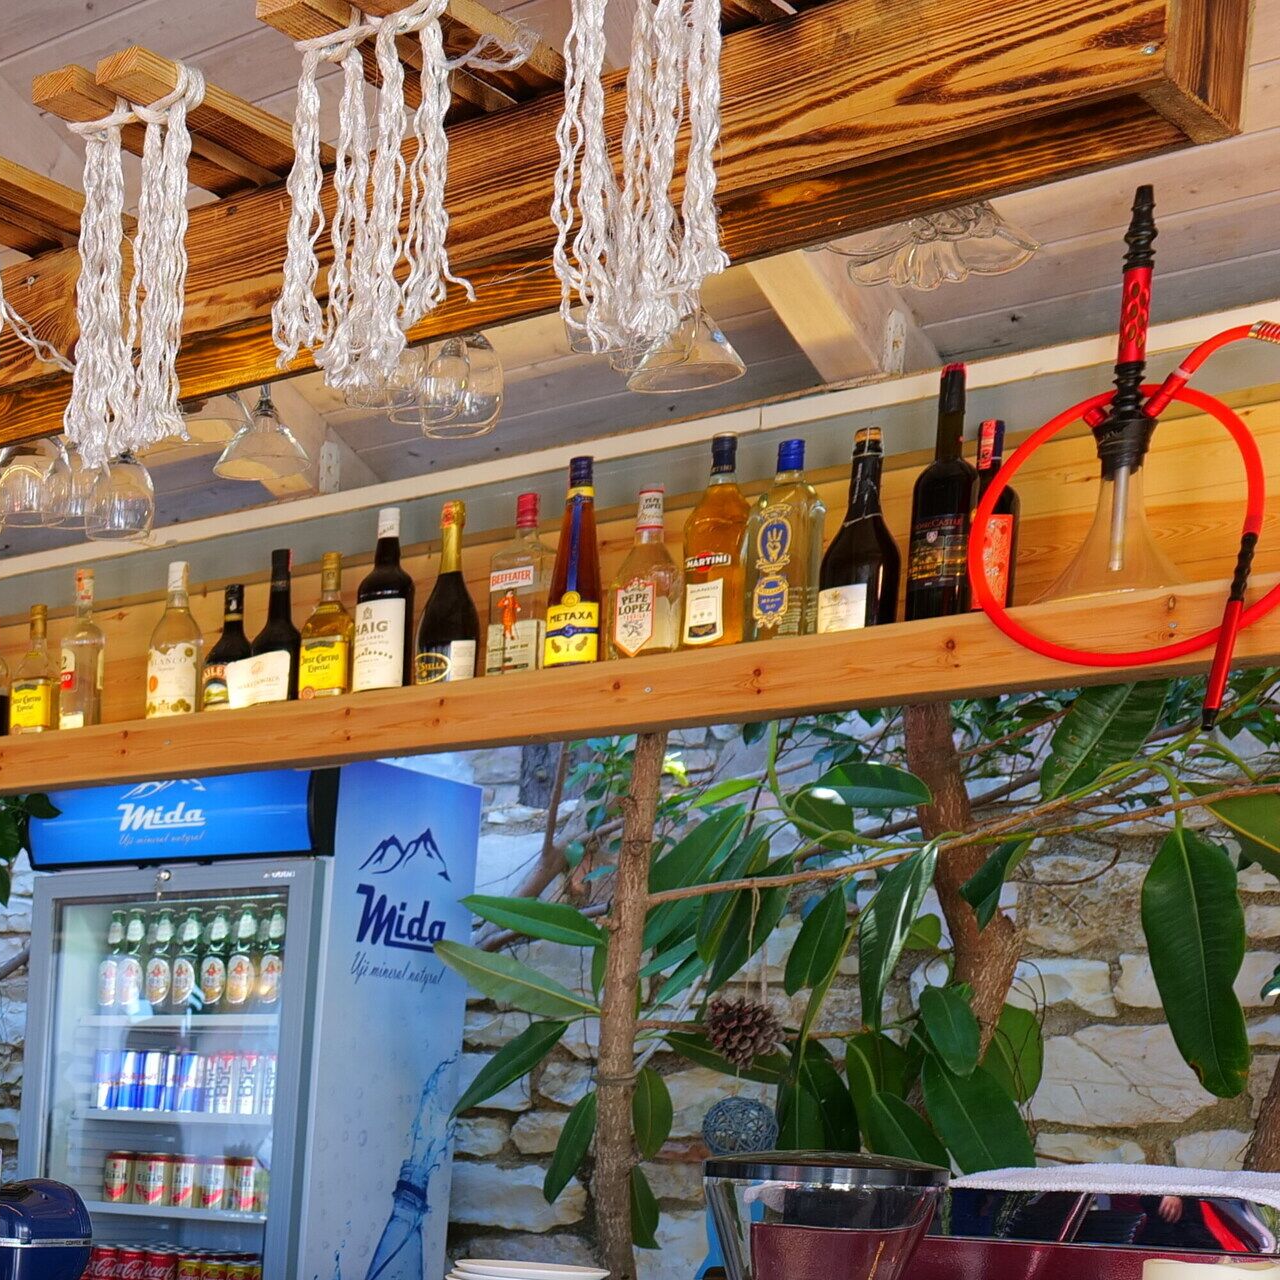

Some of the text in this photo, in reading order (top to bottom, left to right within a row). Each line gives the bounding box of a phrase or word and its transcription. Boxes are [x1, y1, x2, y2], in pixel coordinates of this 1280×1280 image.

[686, 554, 728, 569] MARTINI
[491, 569, 531, 587] BEEFEATER
[622, 593, 649, 606] PEPE
[618, 602, 652, 616] LOPEZ
[549, 611, 594, 623] METAXA
[117, 801, 207, 831] Mida
[356, 883, 447, 953] Mida
